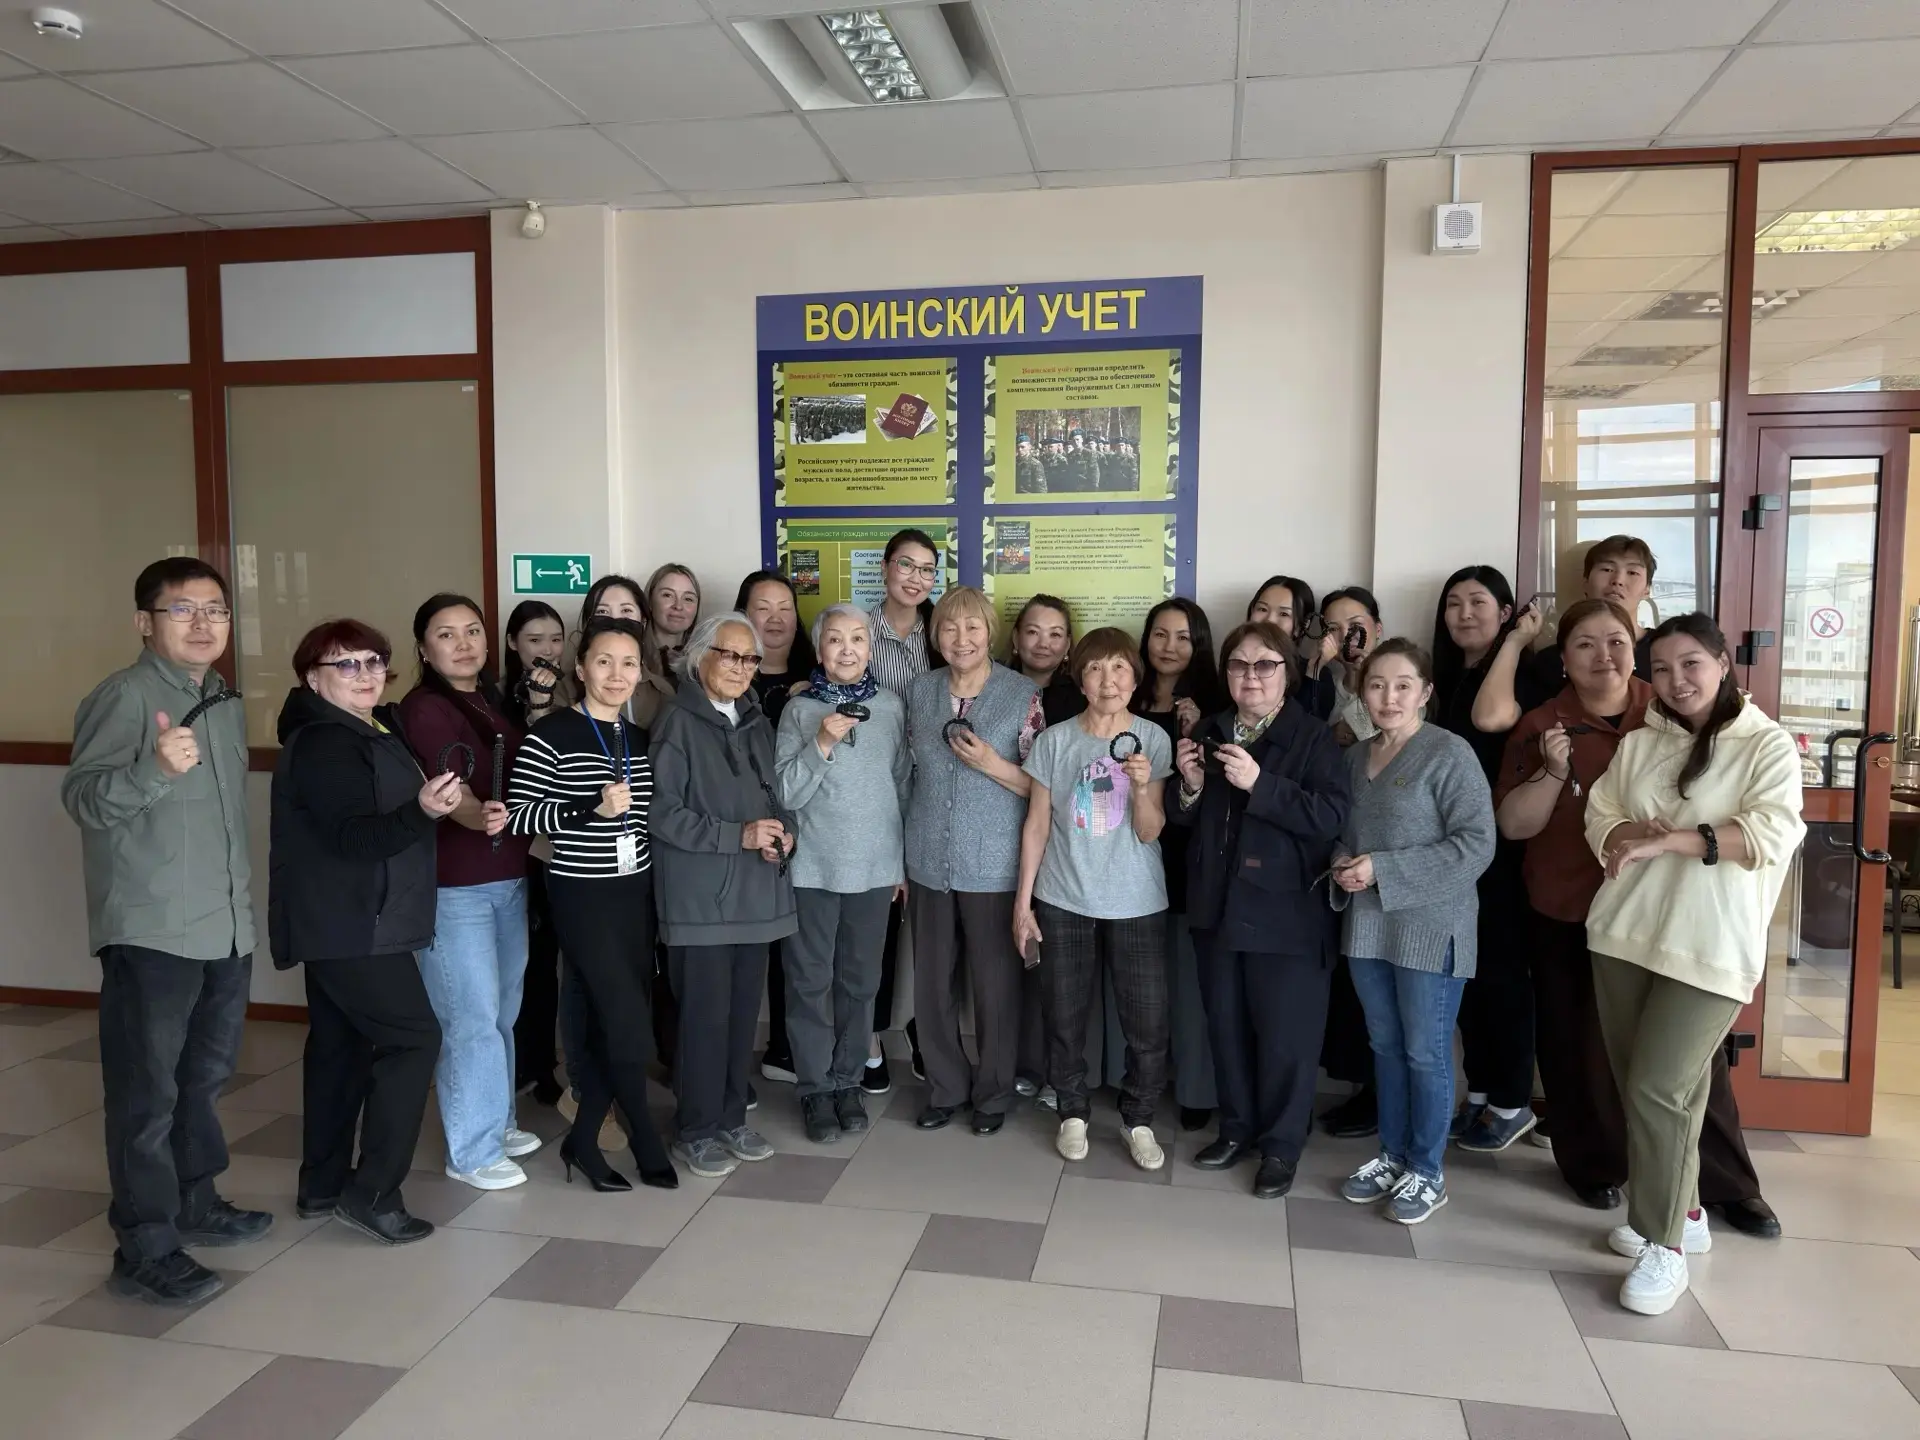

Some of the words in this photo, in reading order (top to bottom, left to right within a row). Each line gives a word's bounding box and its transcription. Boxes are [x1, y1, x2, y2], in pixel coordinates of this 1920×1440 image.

[805, 286, 1027, 342] ВОИНСКИЙ
[1038, 289, 1147, 334] УЧЕТ
[1104, 364, 1146, 372] определить
[1057, 375, 1099, 384] государства
[869, 380, 900, 388] граждан.
